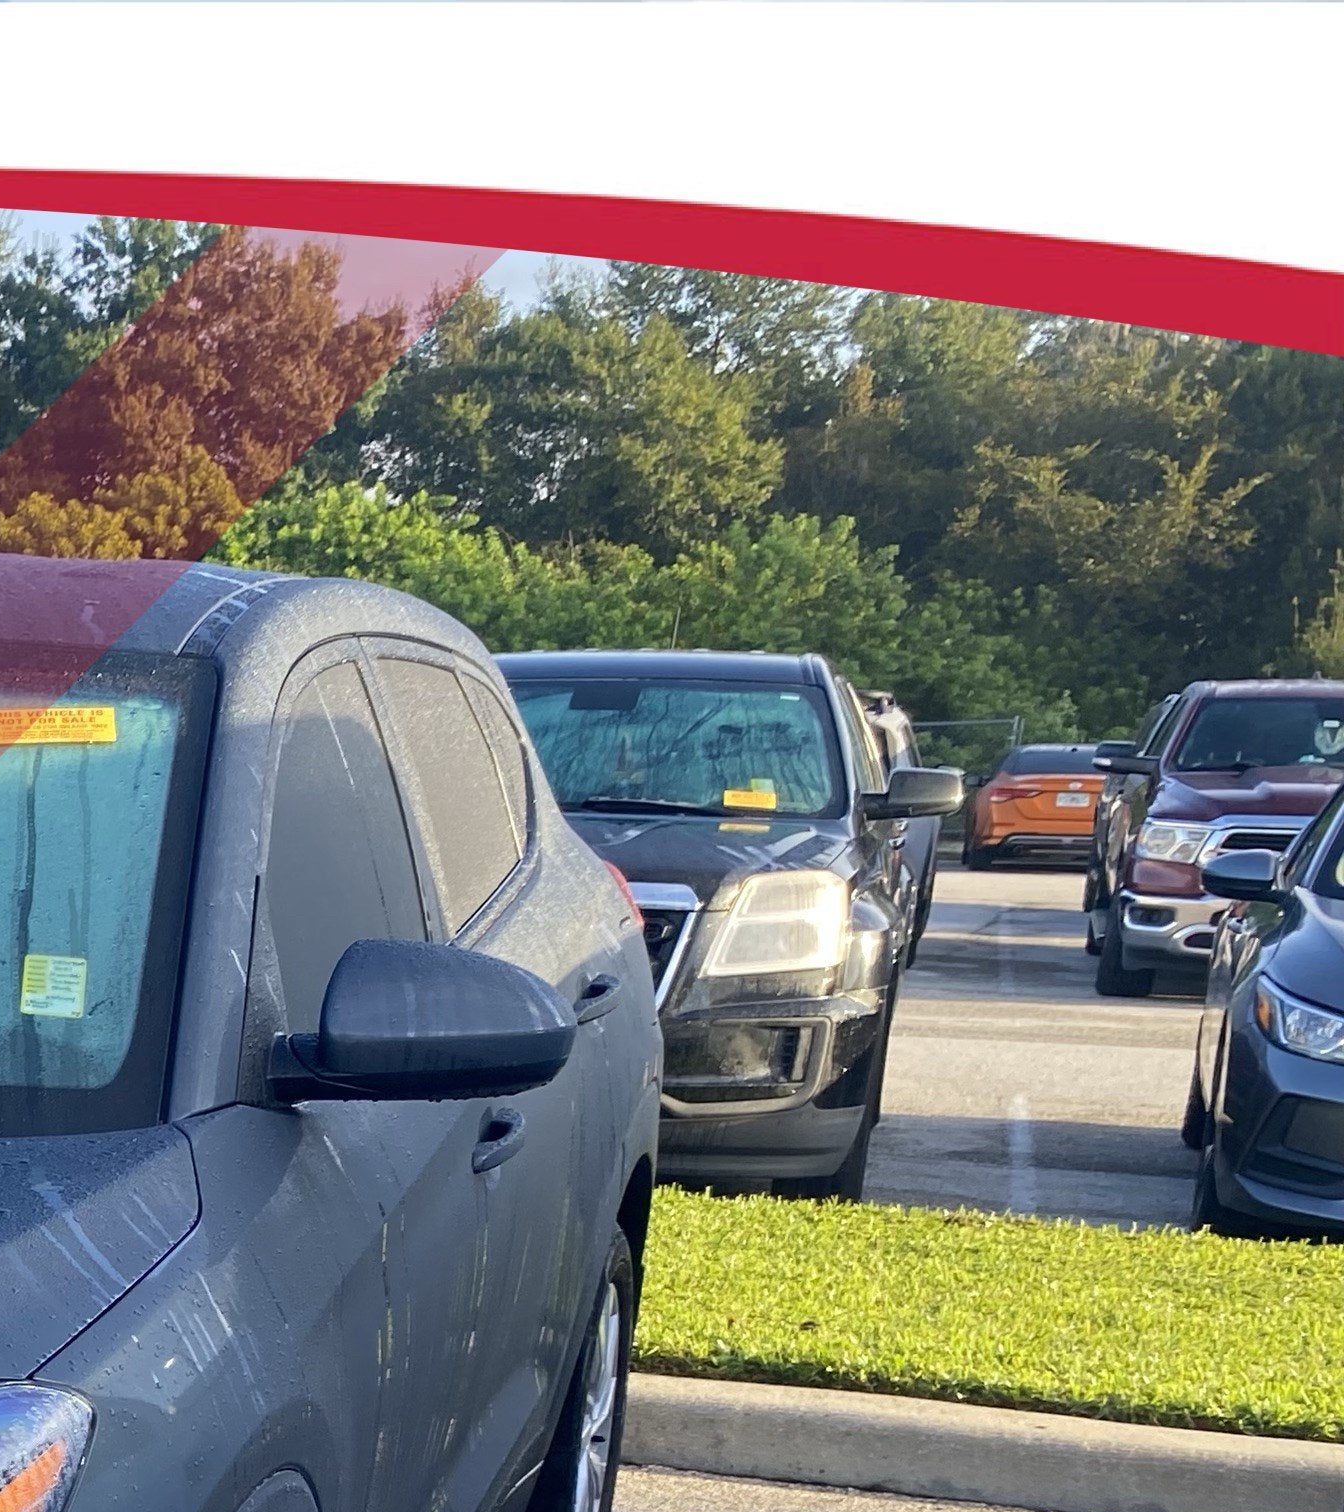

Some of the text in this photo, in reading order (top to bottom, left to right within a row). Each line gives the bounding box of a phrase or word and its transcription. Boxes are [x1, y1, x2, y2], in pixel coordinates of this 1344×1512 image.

[27, 709, 83, 717] VEHICLE
[29, 717, 56, 725] FOR
[61, 716, 97, 724] SALE
